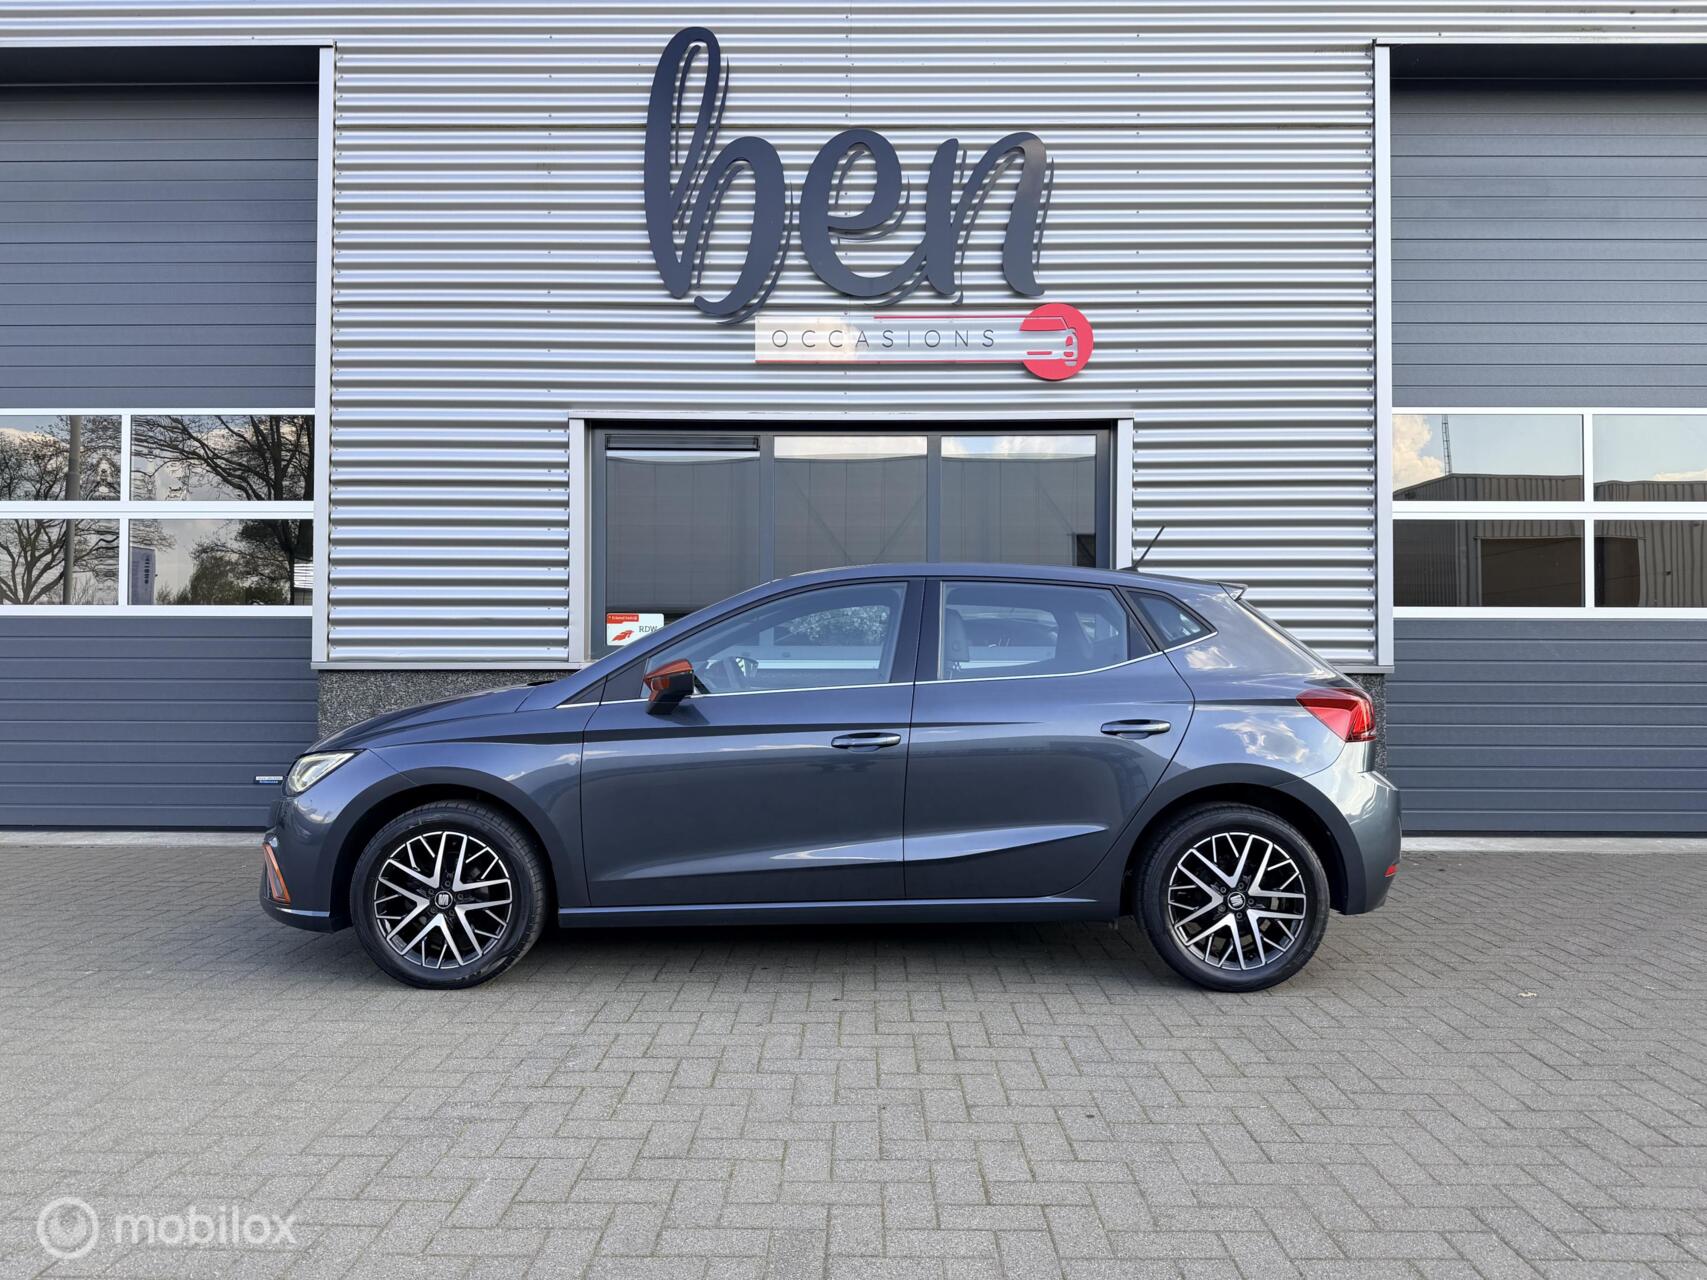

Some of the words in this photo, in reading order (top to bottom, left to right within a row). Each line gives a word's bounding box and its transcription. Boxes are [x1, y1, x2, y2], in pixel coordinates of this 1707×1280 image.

[644, 26, 1049, 318] ben
[771, 329, 995, 348] OCCASIONS
[638, 625, 658, 633] RDW
